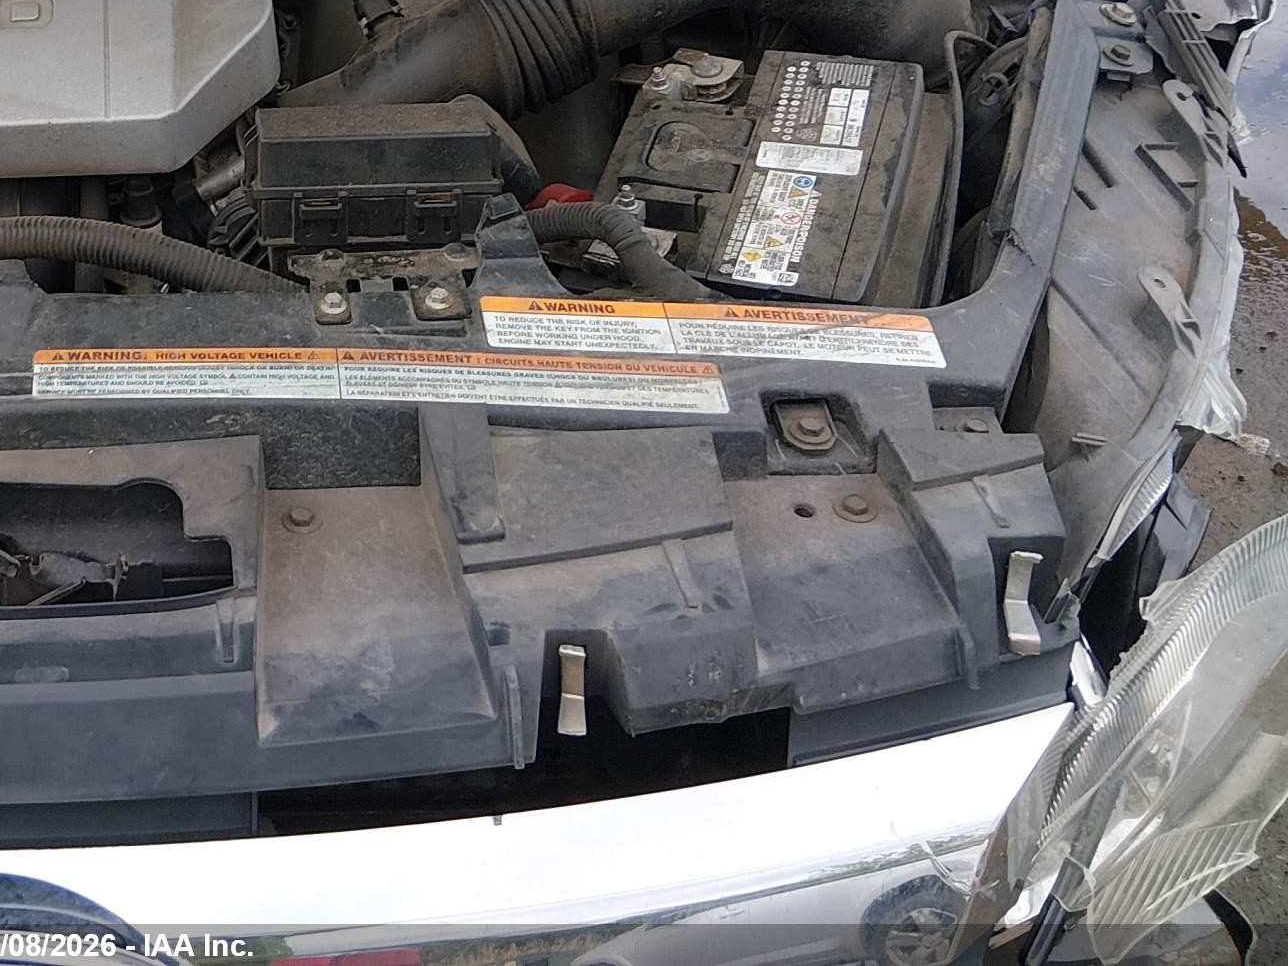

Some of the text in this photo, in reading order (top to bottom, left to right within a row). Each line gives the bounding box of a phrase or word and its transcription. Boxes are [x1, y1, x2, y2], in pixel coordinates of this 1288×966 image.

[544, 302, 615, 314] WARNING
[744, 309, 868, 324] AVERTISSEMENT
[156, 352, 186, 360] HIGH
[190, 352, 245, 360] VOLTAGE
[252, 352, 302, 360] VEHICLE
[360, 352, 472, 364] AVERTISSEMENT
[485, 358, 533, 367] CIRCUITS
[536, 360, 574, 369] HAUTE
[576, 362, 622, 370] TENSION
[626, 364, 641, 372] DU
